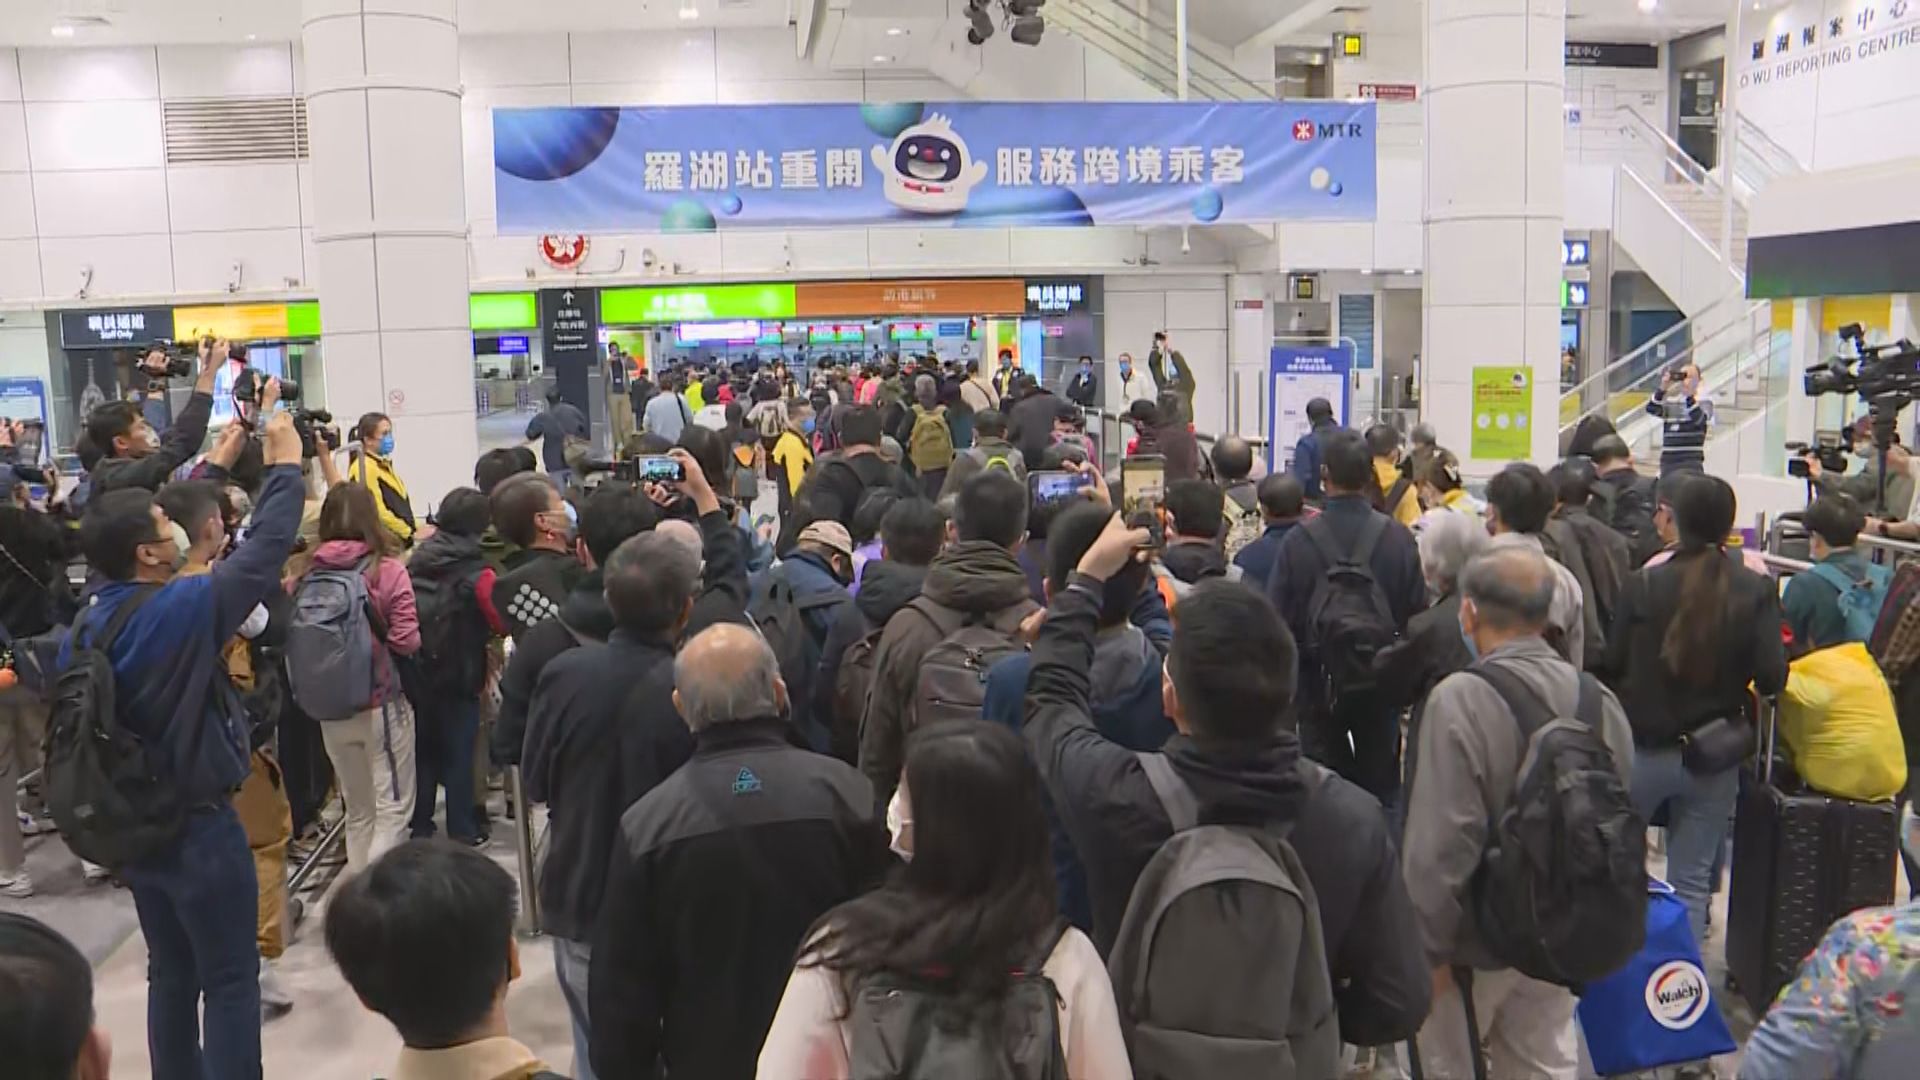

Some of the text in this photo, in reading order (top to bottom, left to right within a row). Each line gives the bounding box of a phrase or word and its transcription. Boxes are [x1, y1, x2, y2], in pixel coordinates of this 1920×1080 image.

[1753, 68, 1771, 85] WU
[1776, 46, 1851, 79] REPORTING
[1858, 26, 1920, 58] CENTRE
[1318, 122, 1363, 138] MTR
[644, 145, 1246, 192] 羅湖站重開 服務跨境乘客
[117, 330, 133, 341] Only
[1657, 984, 1699, 1005] Walch
